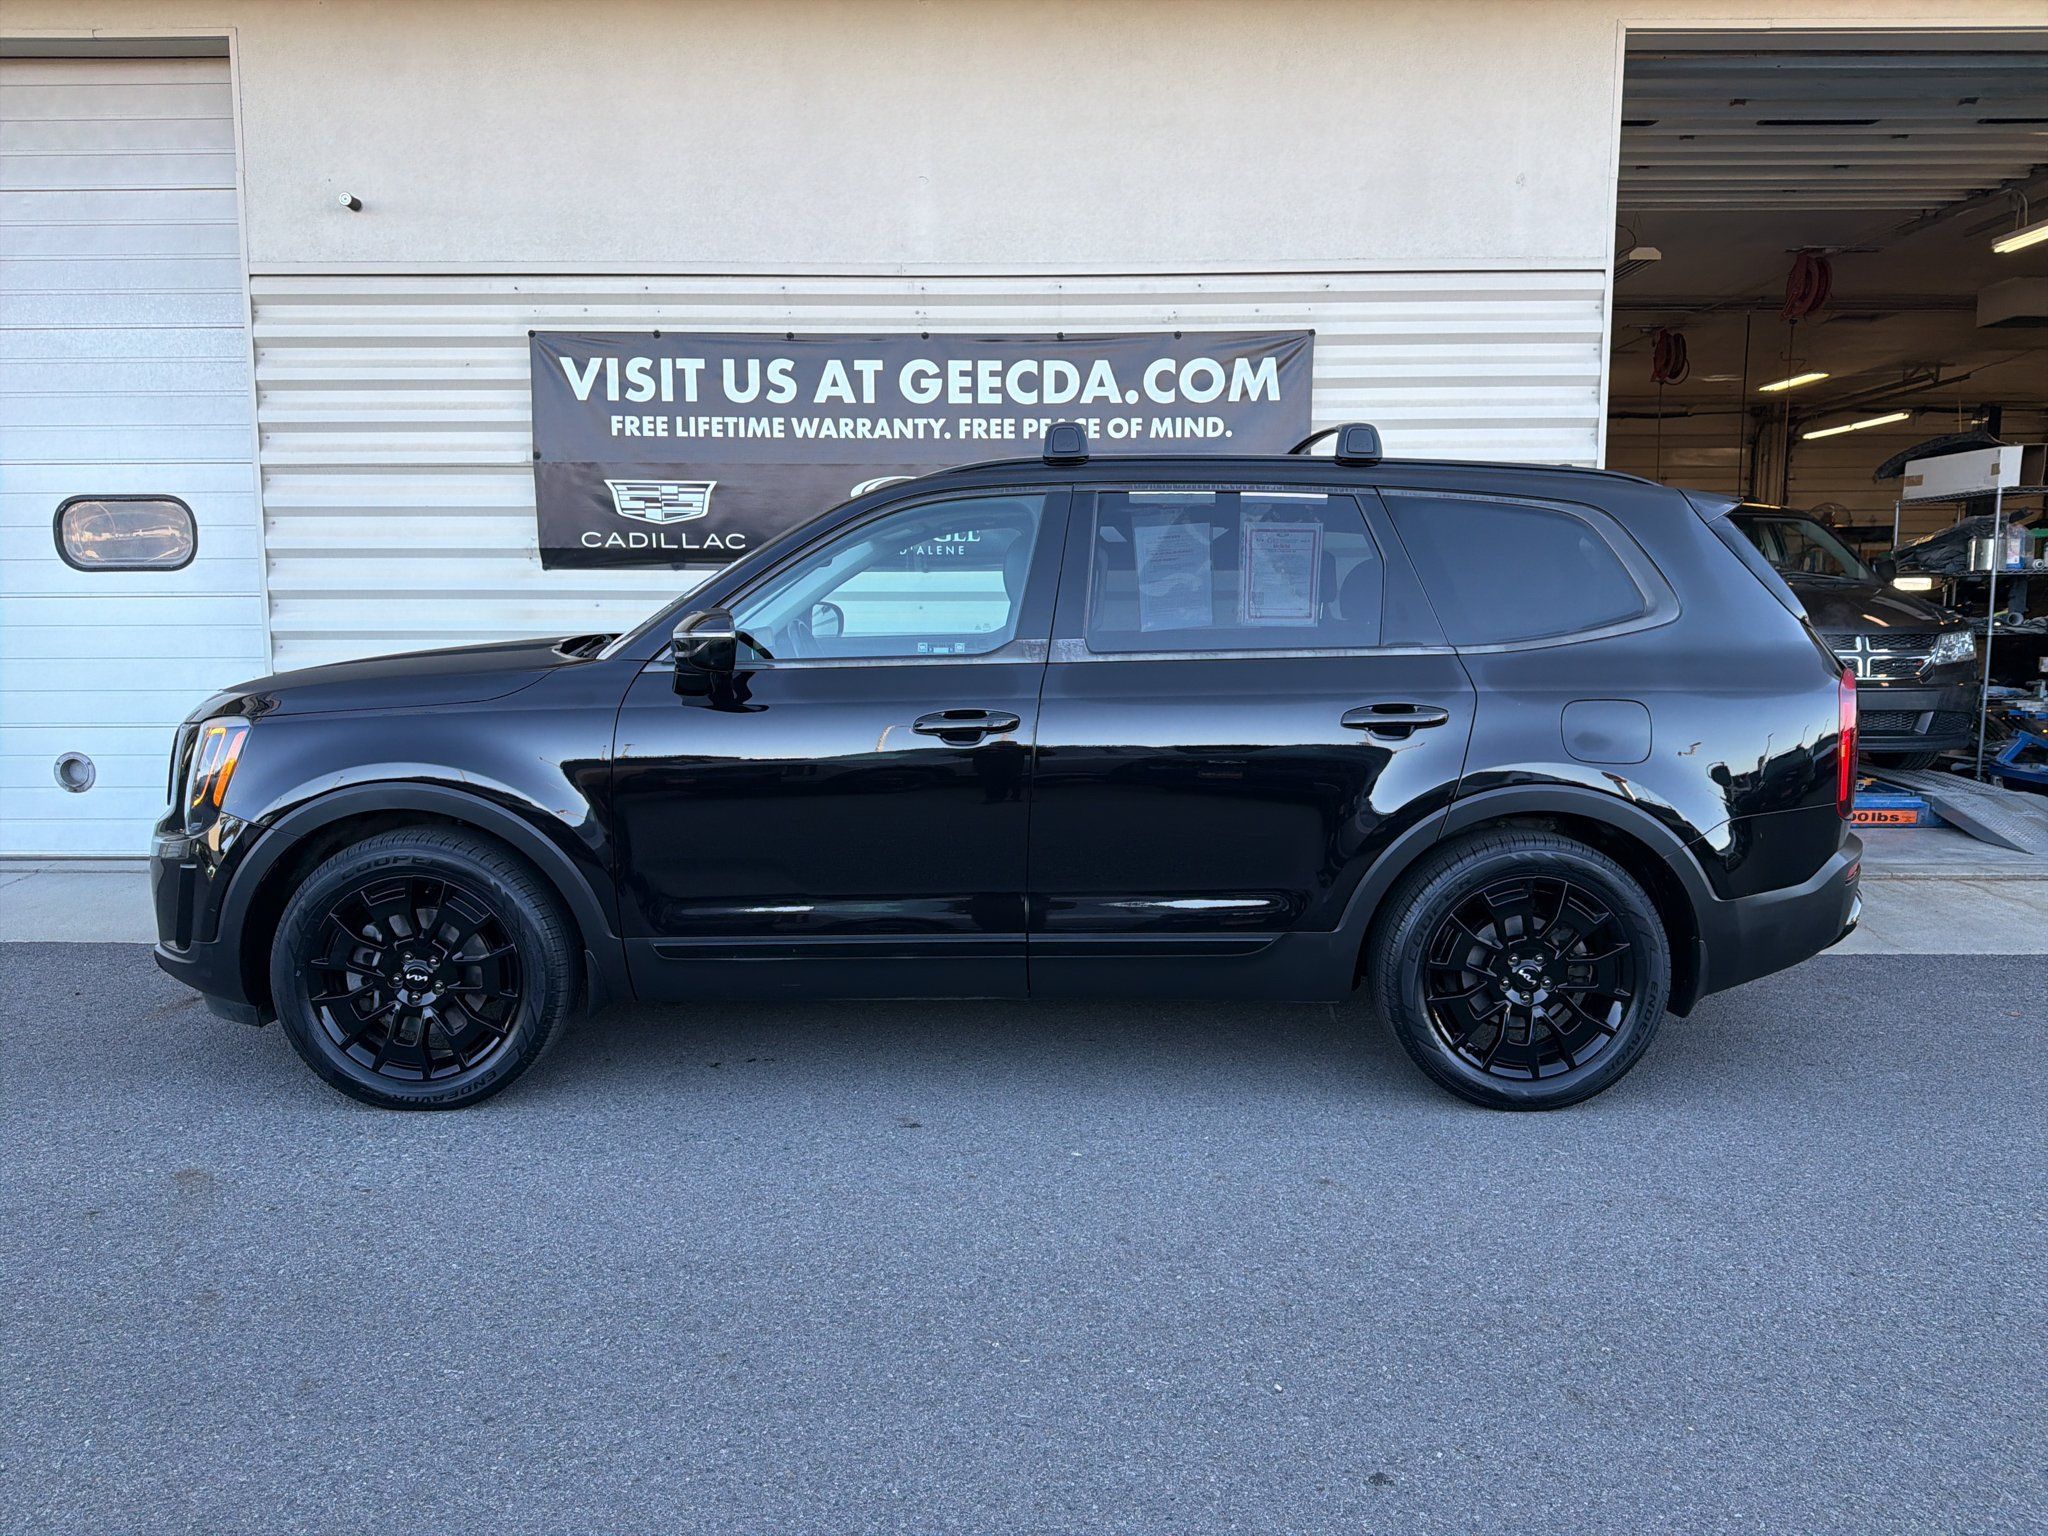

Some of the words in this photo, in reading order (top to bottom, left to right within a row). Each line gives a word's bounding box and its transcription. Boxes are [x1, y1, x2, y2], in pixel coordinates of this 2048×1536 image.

[558, 356, 706, 403] VISIT
[722, 358, 798, 404] US
[812, 359, 884, 404] AT
[898, 356, 1281, 406] GEECDA.COM
[610, 415, 669, 438] FREE
[675, 416, 786, 439] LIFETIME
[790, 417, 952, 440] WARRANTY.
[958, 417, 1016, 440] FREE
[1022, 417, 1101, 440] PEE
[1106, 417, 1143, 440] OF
[1149, 416, 1233, 439] MIND.
[580, 531, 746, 550] CADILLAC
